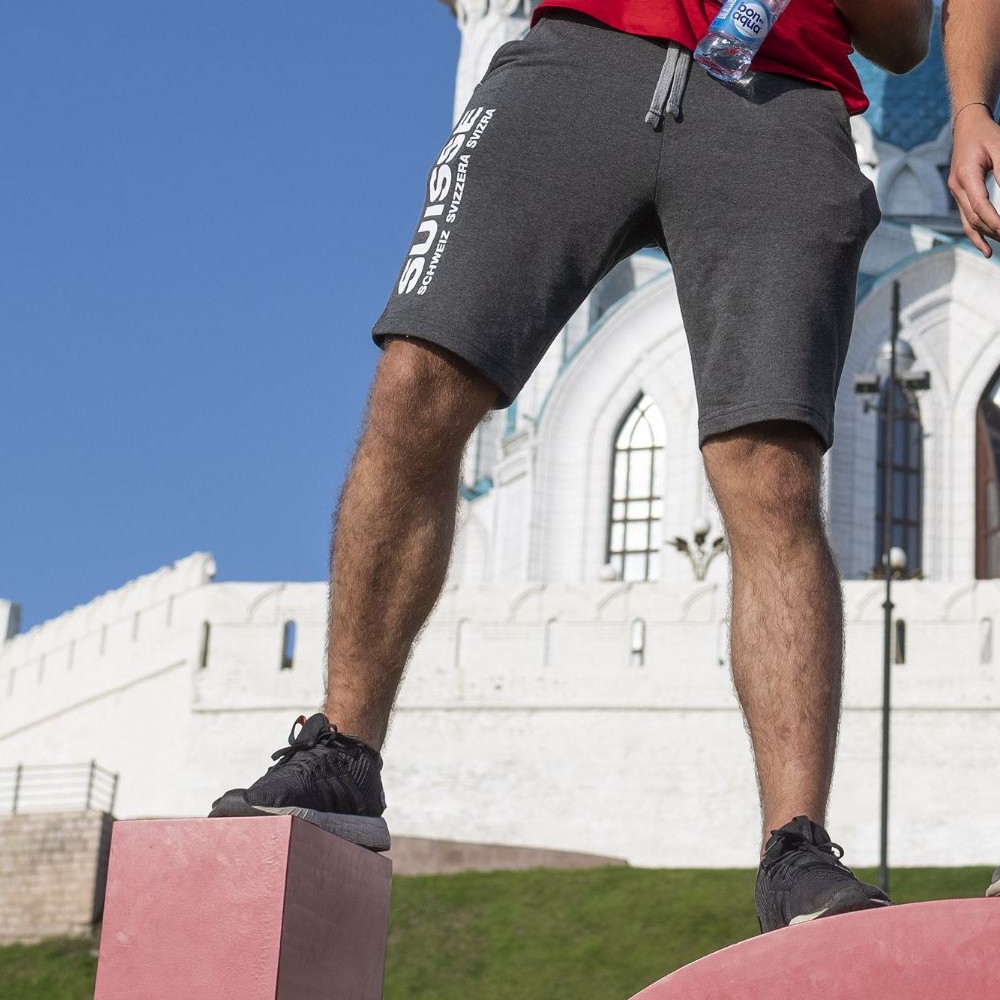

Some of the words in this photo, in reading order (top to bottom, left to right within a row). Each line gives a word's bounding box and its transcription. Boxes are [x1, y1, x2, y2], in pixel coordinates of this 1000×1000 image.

[733, 12, 762, 35] aqua
[737, 1, 761, 21] bon
[397, 106, 484, 296] SUISSE
[416, 229, 452, 296] SCHWEIZ
[445, 153, 471, 224] SVIZZERA
[465, 107, 497, 149] SVIZRA
